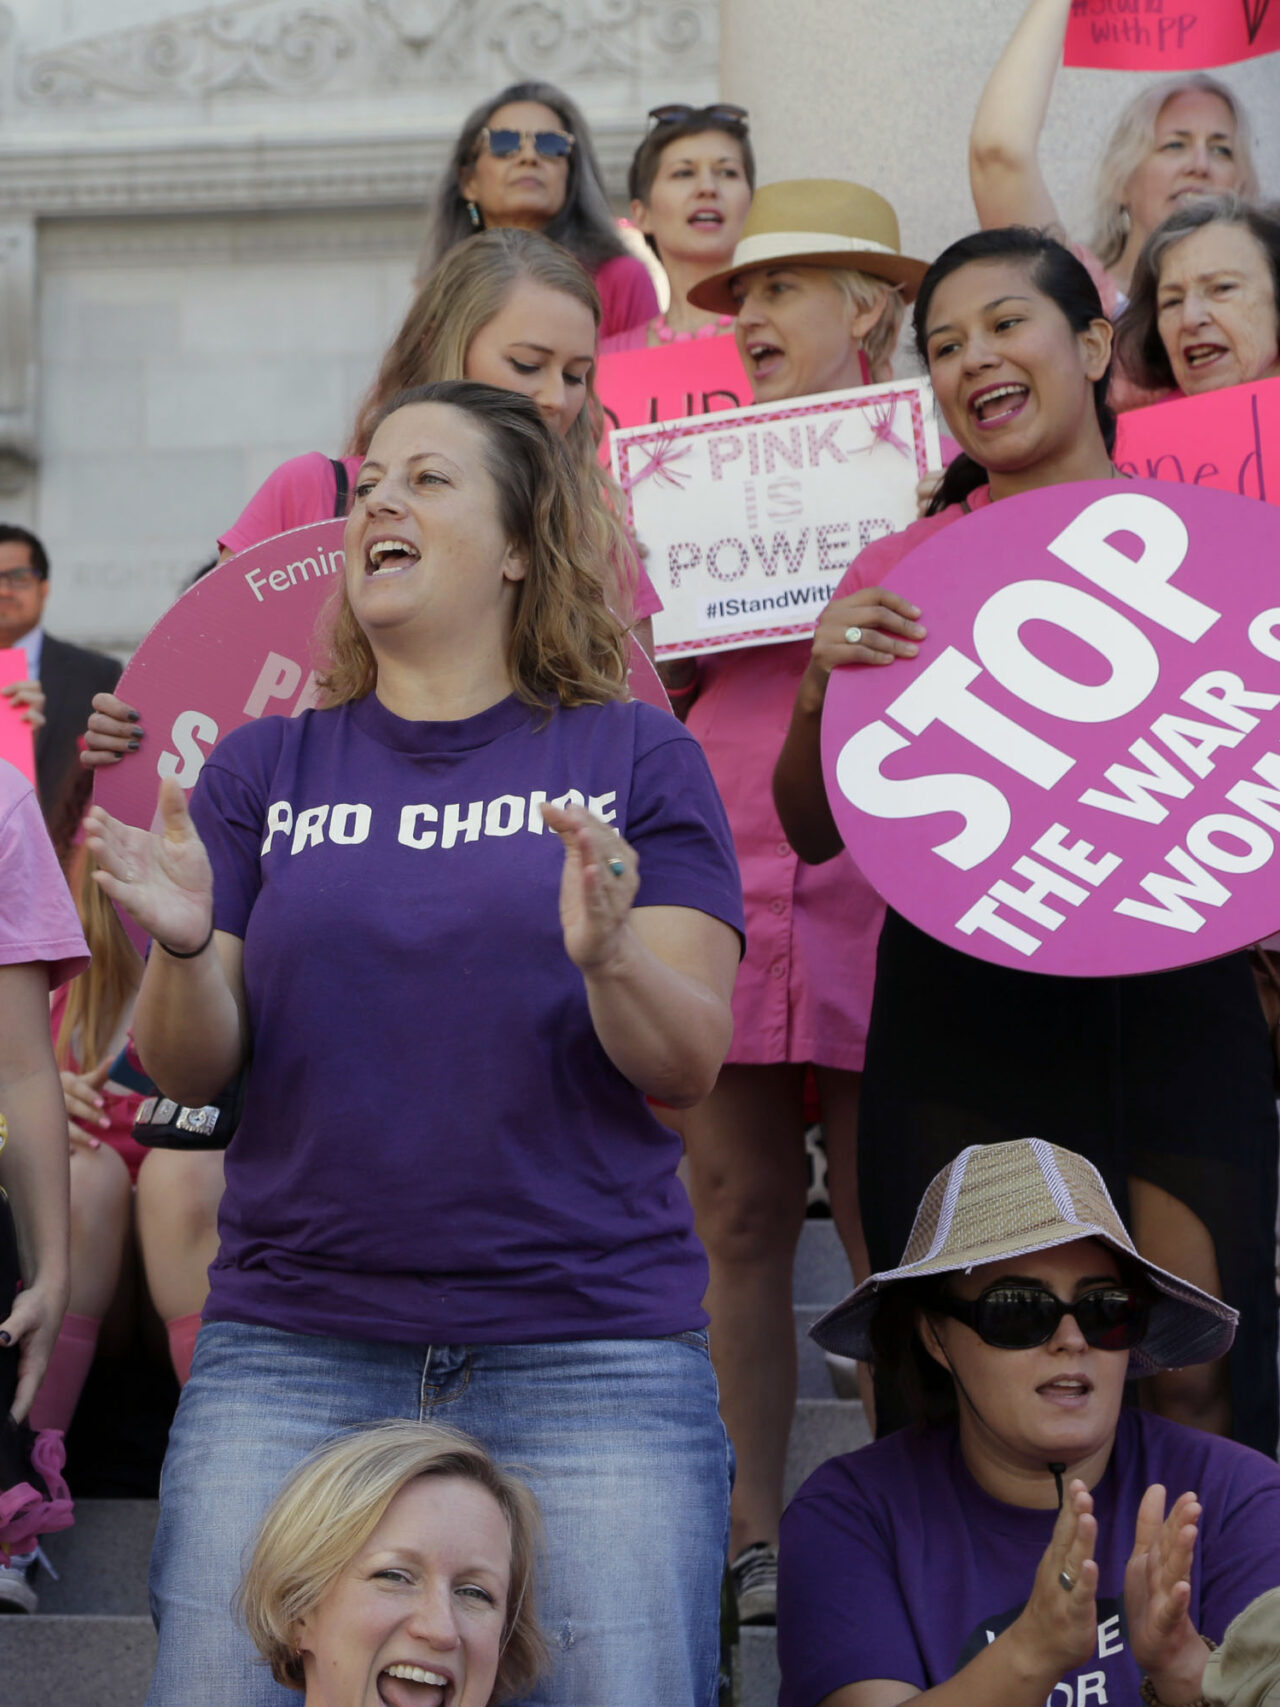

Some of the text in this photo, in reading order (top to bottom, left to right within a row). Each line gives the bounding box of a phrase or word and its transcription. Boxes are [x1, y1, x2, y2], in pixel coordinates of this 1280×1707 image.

[1158, 16, 1197, 51] PP
[707, 419, 848, 480] PINK
[743, 476, 803, 529] IS
[245, 546, 346, 602] Femin
[836, 493, 1222, 871] STOP
[261, 800, 372, 857] PRO
[954, 670, 1280, 957] THE WAR
